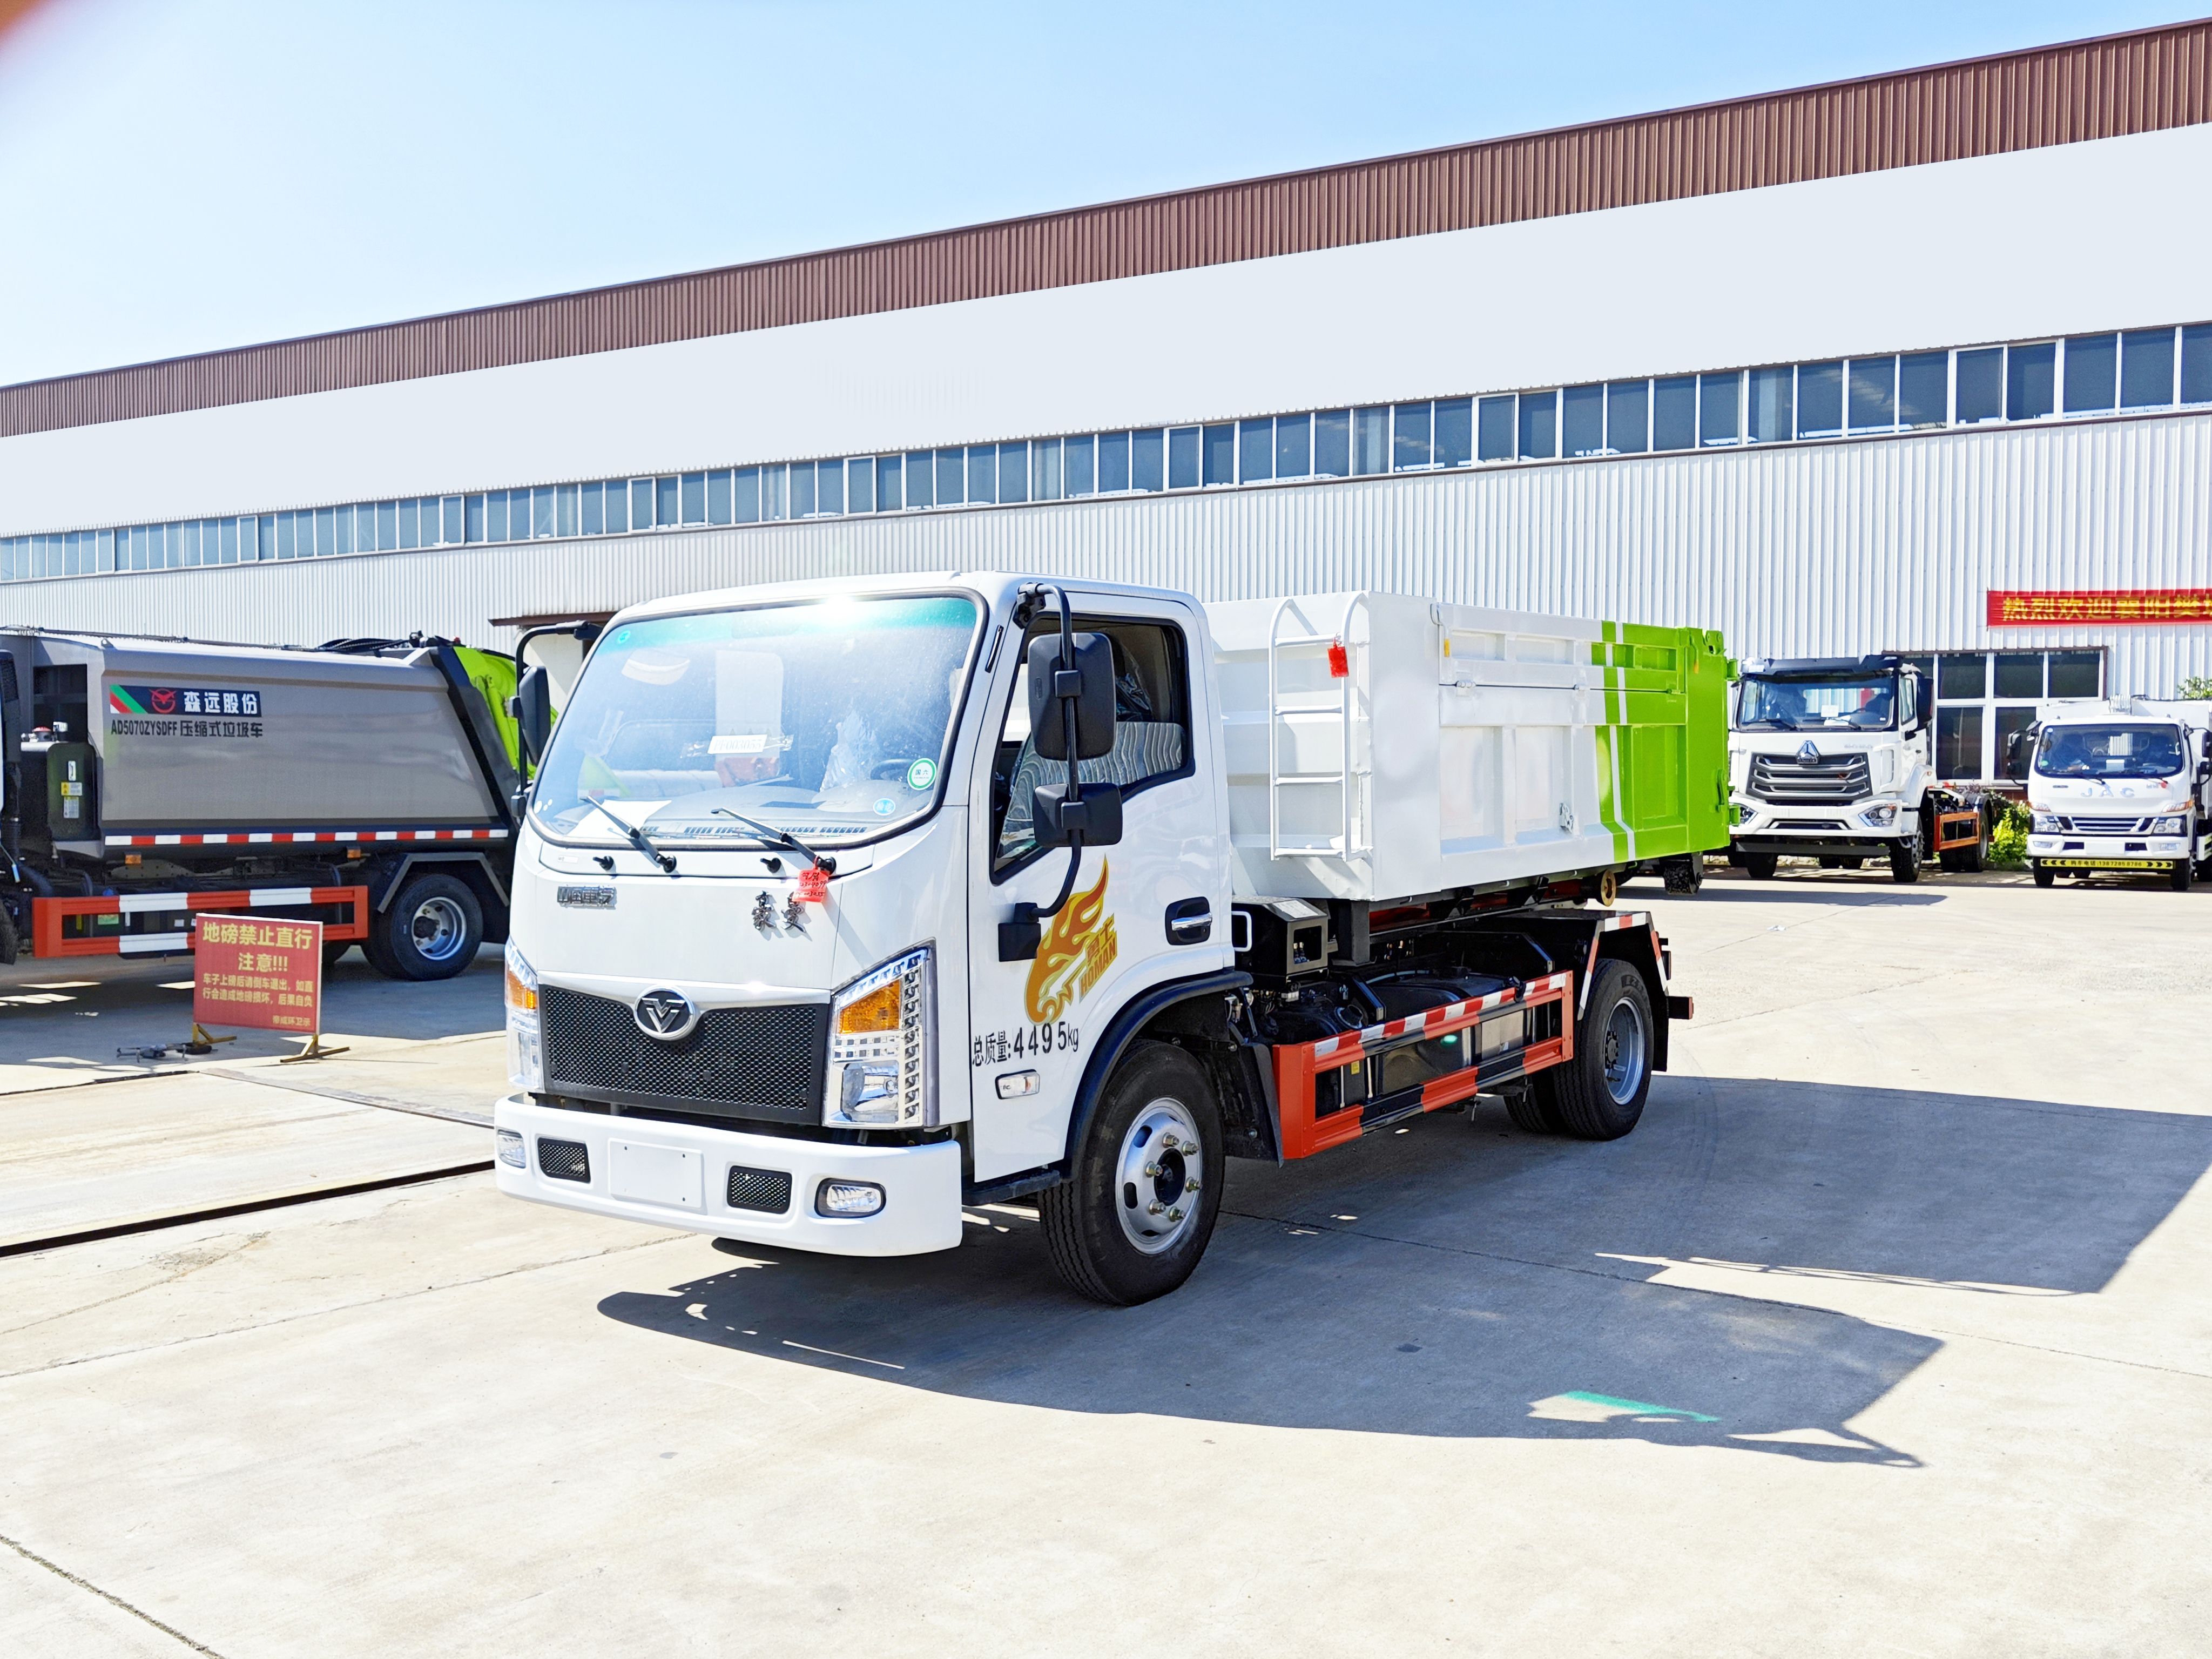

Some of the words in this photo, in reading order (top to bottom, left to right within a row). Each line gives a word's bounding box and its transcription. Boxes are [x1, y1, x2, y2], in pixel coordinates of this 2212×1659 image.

[184, 691, 258, 714] 森远股份
[111, 719, 177, 736] AD5070ZYSDFF
[180, 720, 262, 738] 压缩式垃圾车
[2080, 784, 2135, 797] JAC
[203, 921, 313, 949] 地磅禁止直行
